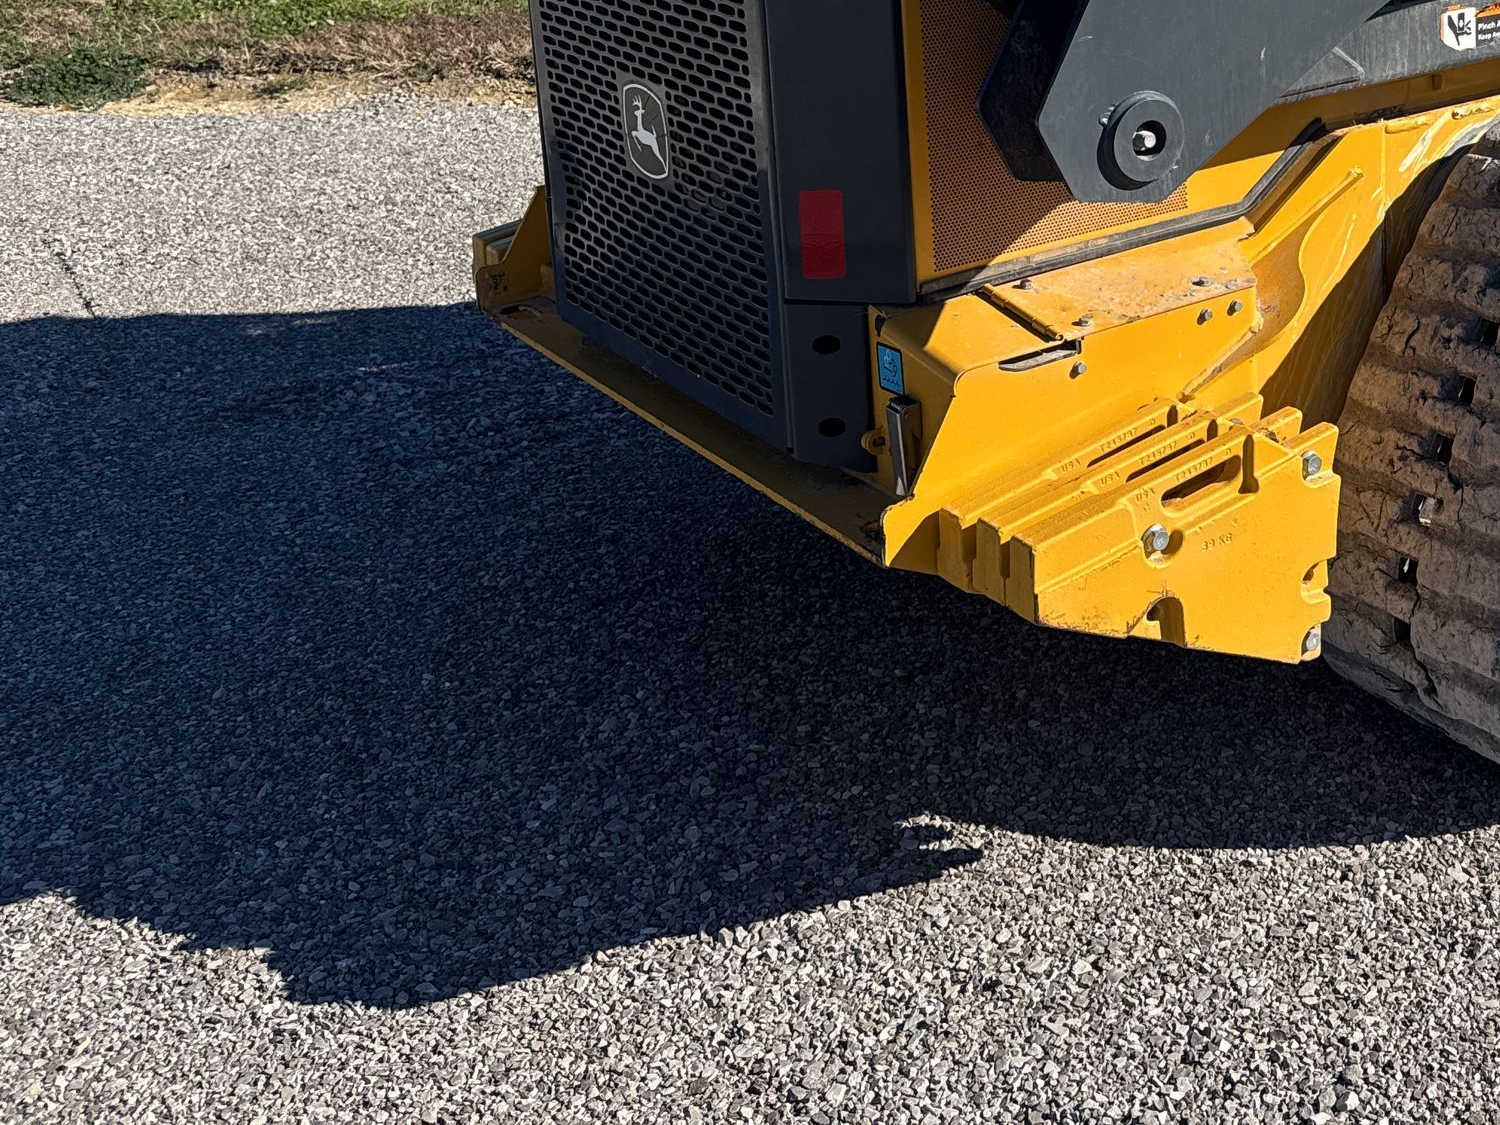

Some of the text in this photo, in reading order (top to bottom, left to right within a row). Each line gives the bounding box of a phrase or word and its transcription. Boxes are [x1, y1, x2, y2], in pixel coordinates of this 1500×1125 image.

[1478, 22, 1495, 30] Pinch
[1478, 33, 1491, 41] Keep
[1062, 459, 1081, 472] USA
[1101, 472, 1120, 485] USA
[1136, 488, 1155, 502] USA
